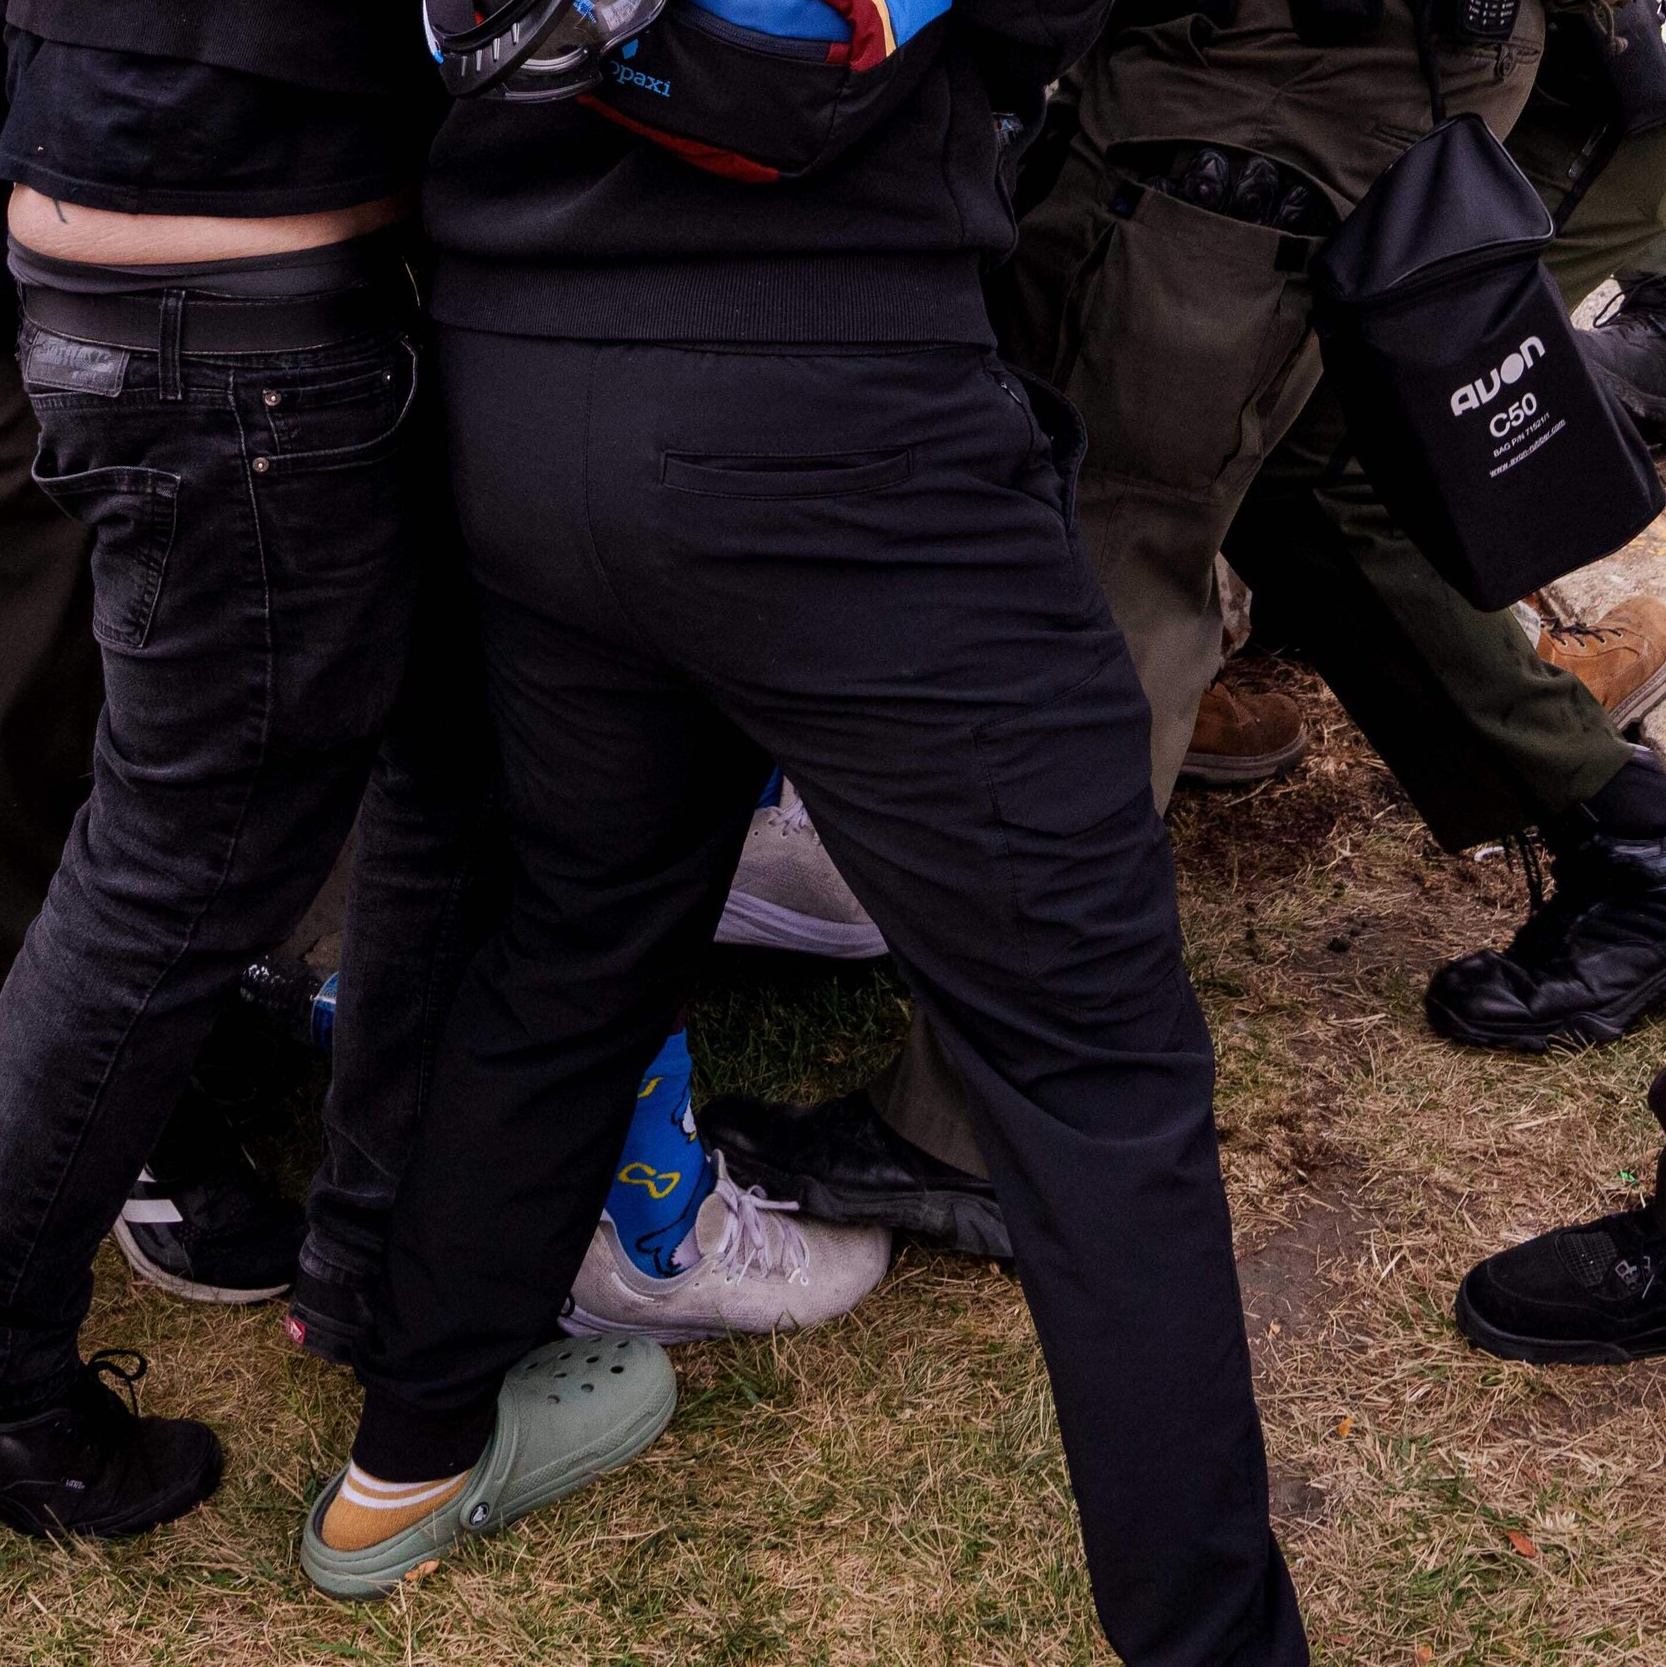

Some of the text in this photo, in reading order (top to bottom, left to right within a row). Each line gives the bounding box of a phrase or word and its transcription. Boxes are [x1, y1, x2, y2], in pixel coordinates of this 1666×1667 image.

[610, 59, 671, 97] opaxi
[1489, 392, 1537, 438] C50
[1493, 412, 1550, 458] BAG P/N 71521/1
[1489, 418, 1567, 478] www.avon-rubber.com
